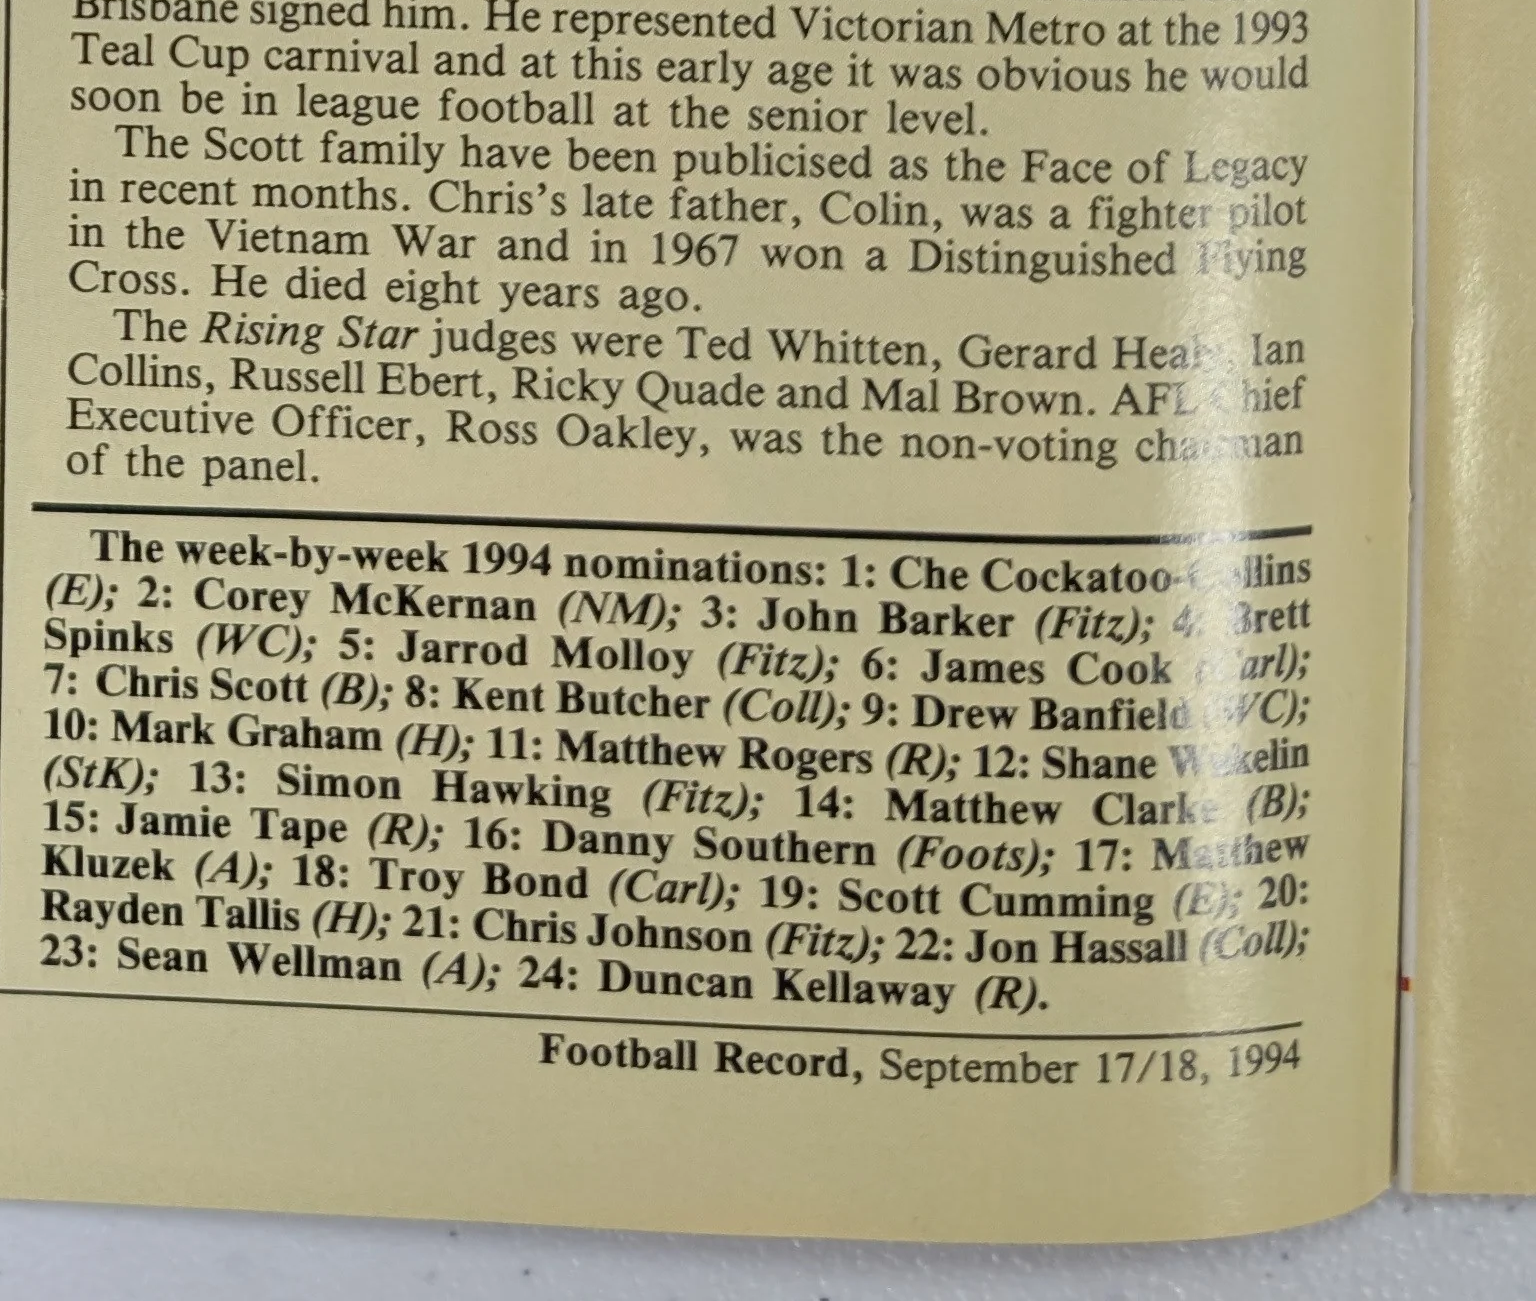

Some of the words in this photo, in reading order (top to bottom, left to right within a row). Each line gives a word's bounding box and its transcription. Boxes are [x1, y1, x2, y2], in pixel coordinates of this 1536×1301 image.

[70, 86, 162, 113] soon
[179, 79, 225, 116] be
[241, 81, 278, 117] in
[296, 82, 420, 127] league
[438, 86, 595, 126] football
[613, 98, 651, 129] at
[668, 93, 730, 130] the
[747, 97, 869, 134] senior
[886, 98, 988, 137] level.
[68, 259, 190, 296] Cross.
[210, 263, 268, 299] He
[285, 265, 368, 302] died
[385, 268, 481, 312] eight
[498, 281, 601, 313] years
[618, 285, 701, 319] ago.
[66, 442, 110, 476] of
[125, 443, 185, 479] the
[201, 448, 319, 488] panel.
[44, 616, 174, 659] Spinks
[196, 621, 317, 664] (WC);
[338, 627, 374, 661] 5:
[396, 629, 529, 667] Jarrod
[550, 634, 694, 680] Molloy
[717, 641, 840, 685] (Fitz);
[861, 646, 898, 682] 6:
[920, 648, 1046, 686] James
[1067, 651, 1172, 686] Cook
[40, 888, 185, 931] Rayden
[195, 894, 301, 932] Tallis
[312, 899, 392, 942] (H);
[402, 903, 459, 940] 21:
[472, 907, 577, 945] Chris
[586, 912, 753, 954] Johnson
[765, 921, 886, 966] (Fitz);
[895, 926, 954, 962] 22:
[964, 928, 1039, 964] Jon
[1049, 928, 1188, 965] Hassall
[39, 932, 97, 969] 23:
[117, 936, 209, 974] Sean
[226, 941, 403, 982] Wellman
[422, 950, 502, 993] (A);
[518, 954, 578, 992] 24:
[597, 958, 754, 1000] Duncan
[772, 967, 957, 1015] Kellaway
[974, 975, 1049, 1017] (R).
[538, 1032, 698, 1072] Football
[713, 1040, 864, 1086] Record,
[879, 1047, 1080, 1090] September
[1097, 1049, 1209, 1086] 17/18,
[1230, 1038, 1301, 1078] 1994
